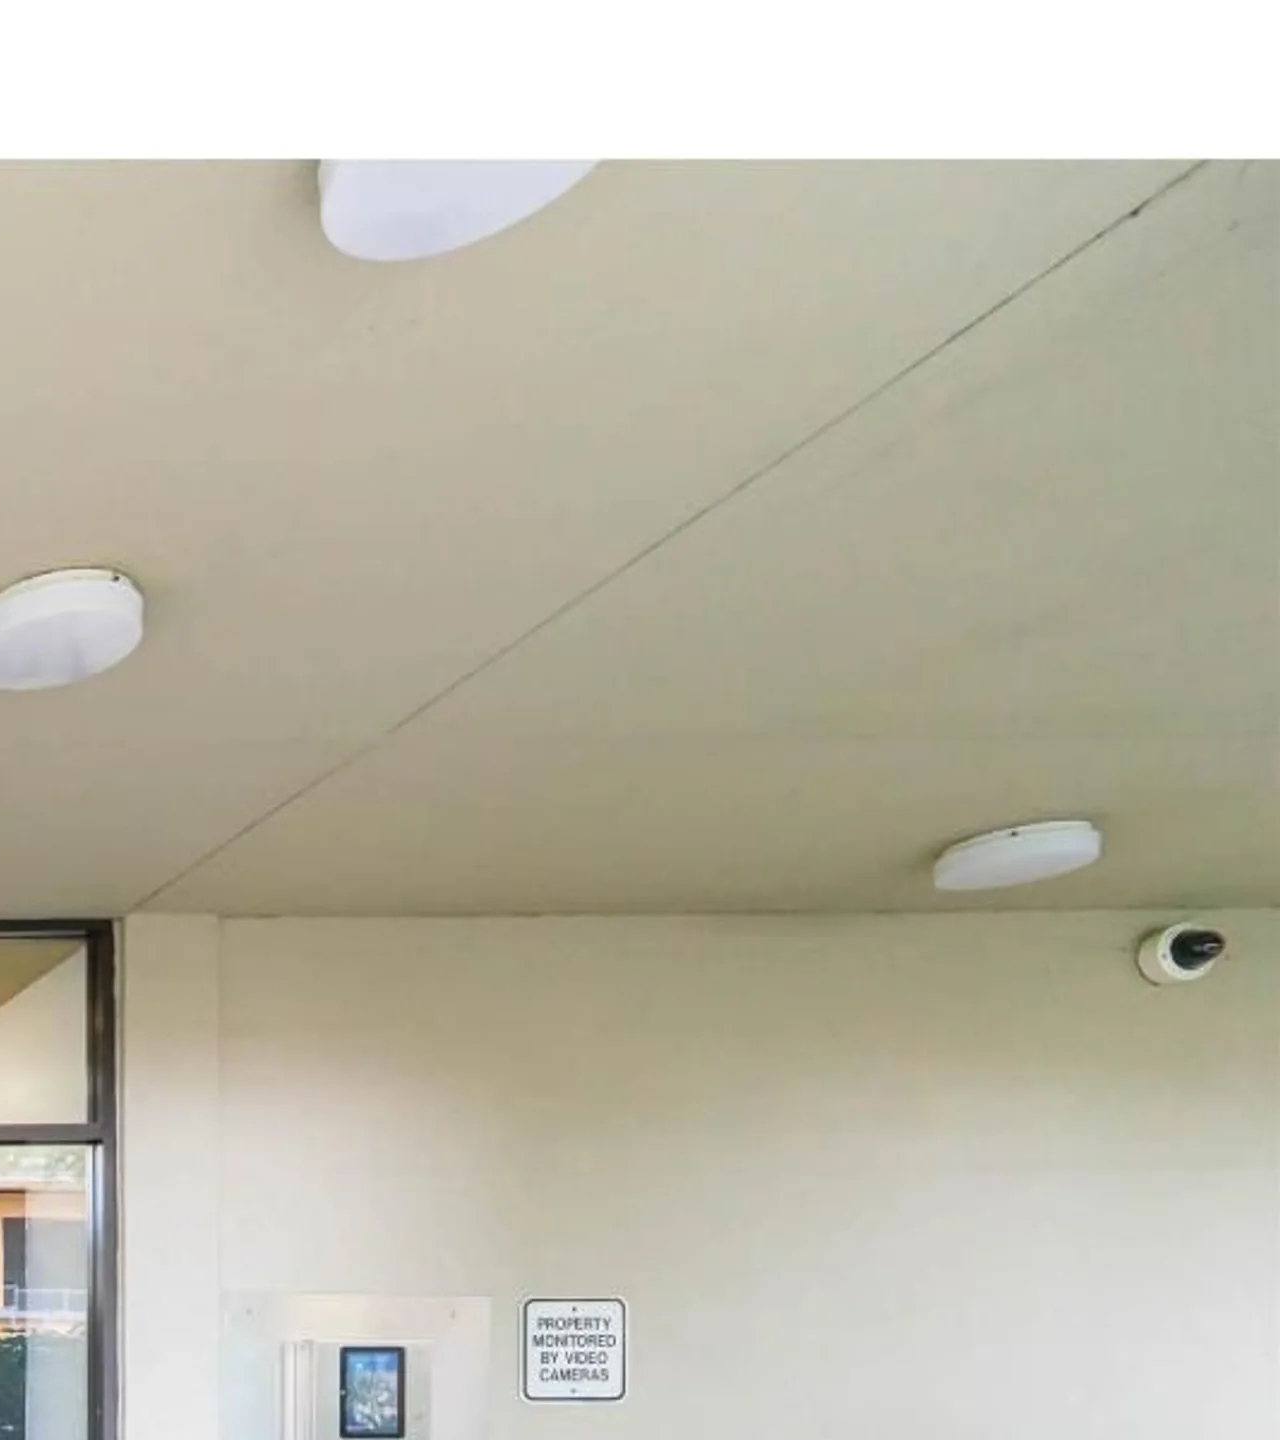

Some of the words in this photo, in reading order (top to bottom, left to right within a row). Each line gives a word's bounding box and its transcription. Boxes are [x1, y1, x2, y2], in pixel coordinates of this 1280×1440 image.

[537, 1317, 612, 1330] PROPERTY
[533, 1334, 616, 1347] MONITORED
[541, 1351, 558, 1364] BY
[565, 1351, 608, 1364] VIDEO
[540, 1368, 609, 1381] CAMERAS
